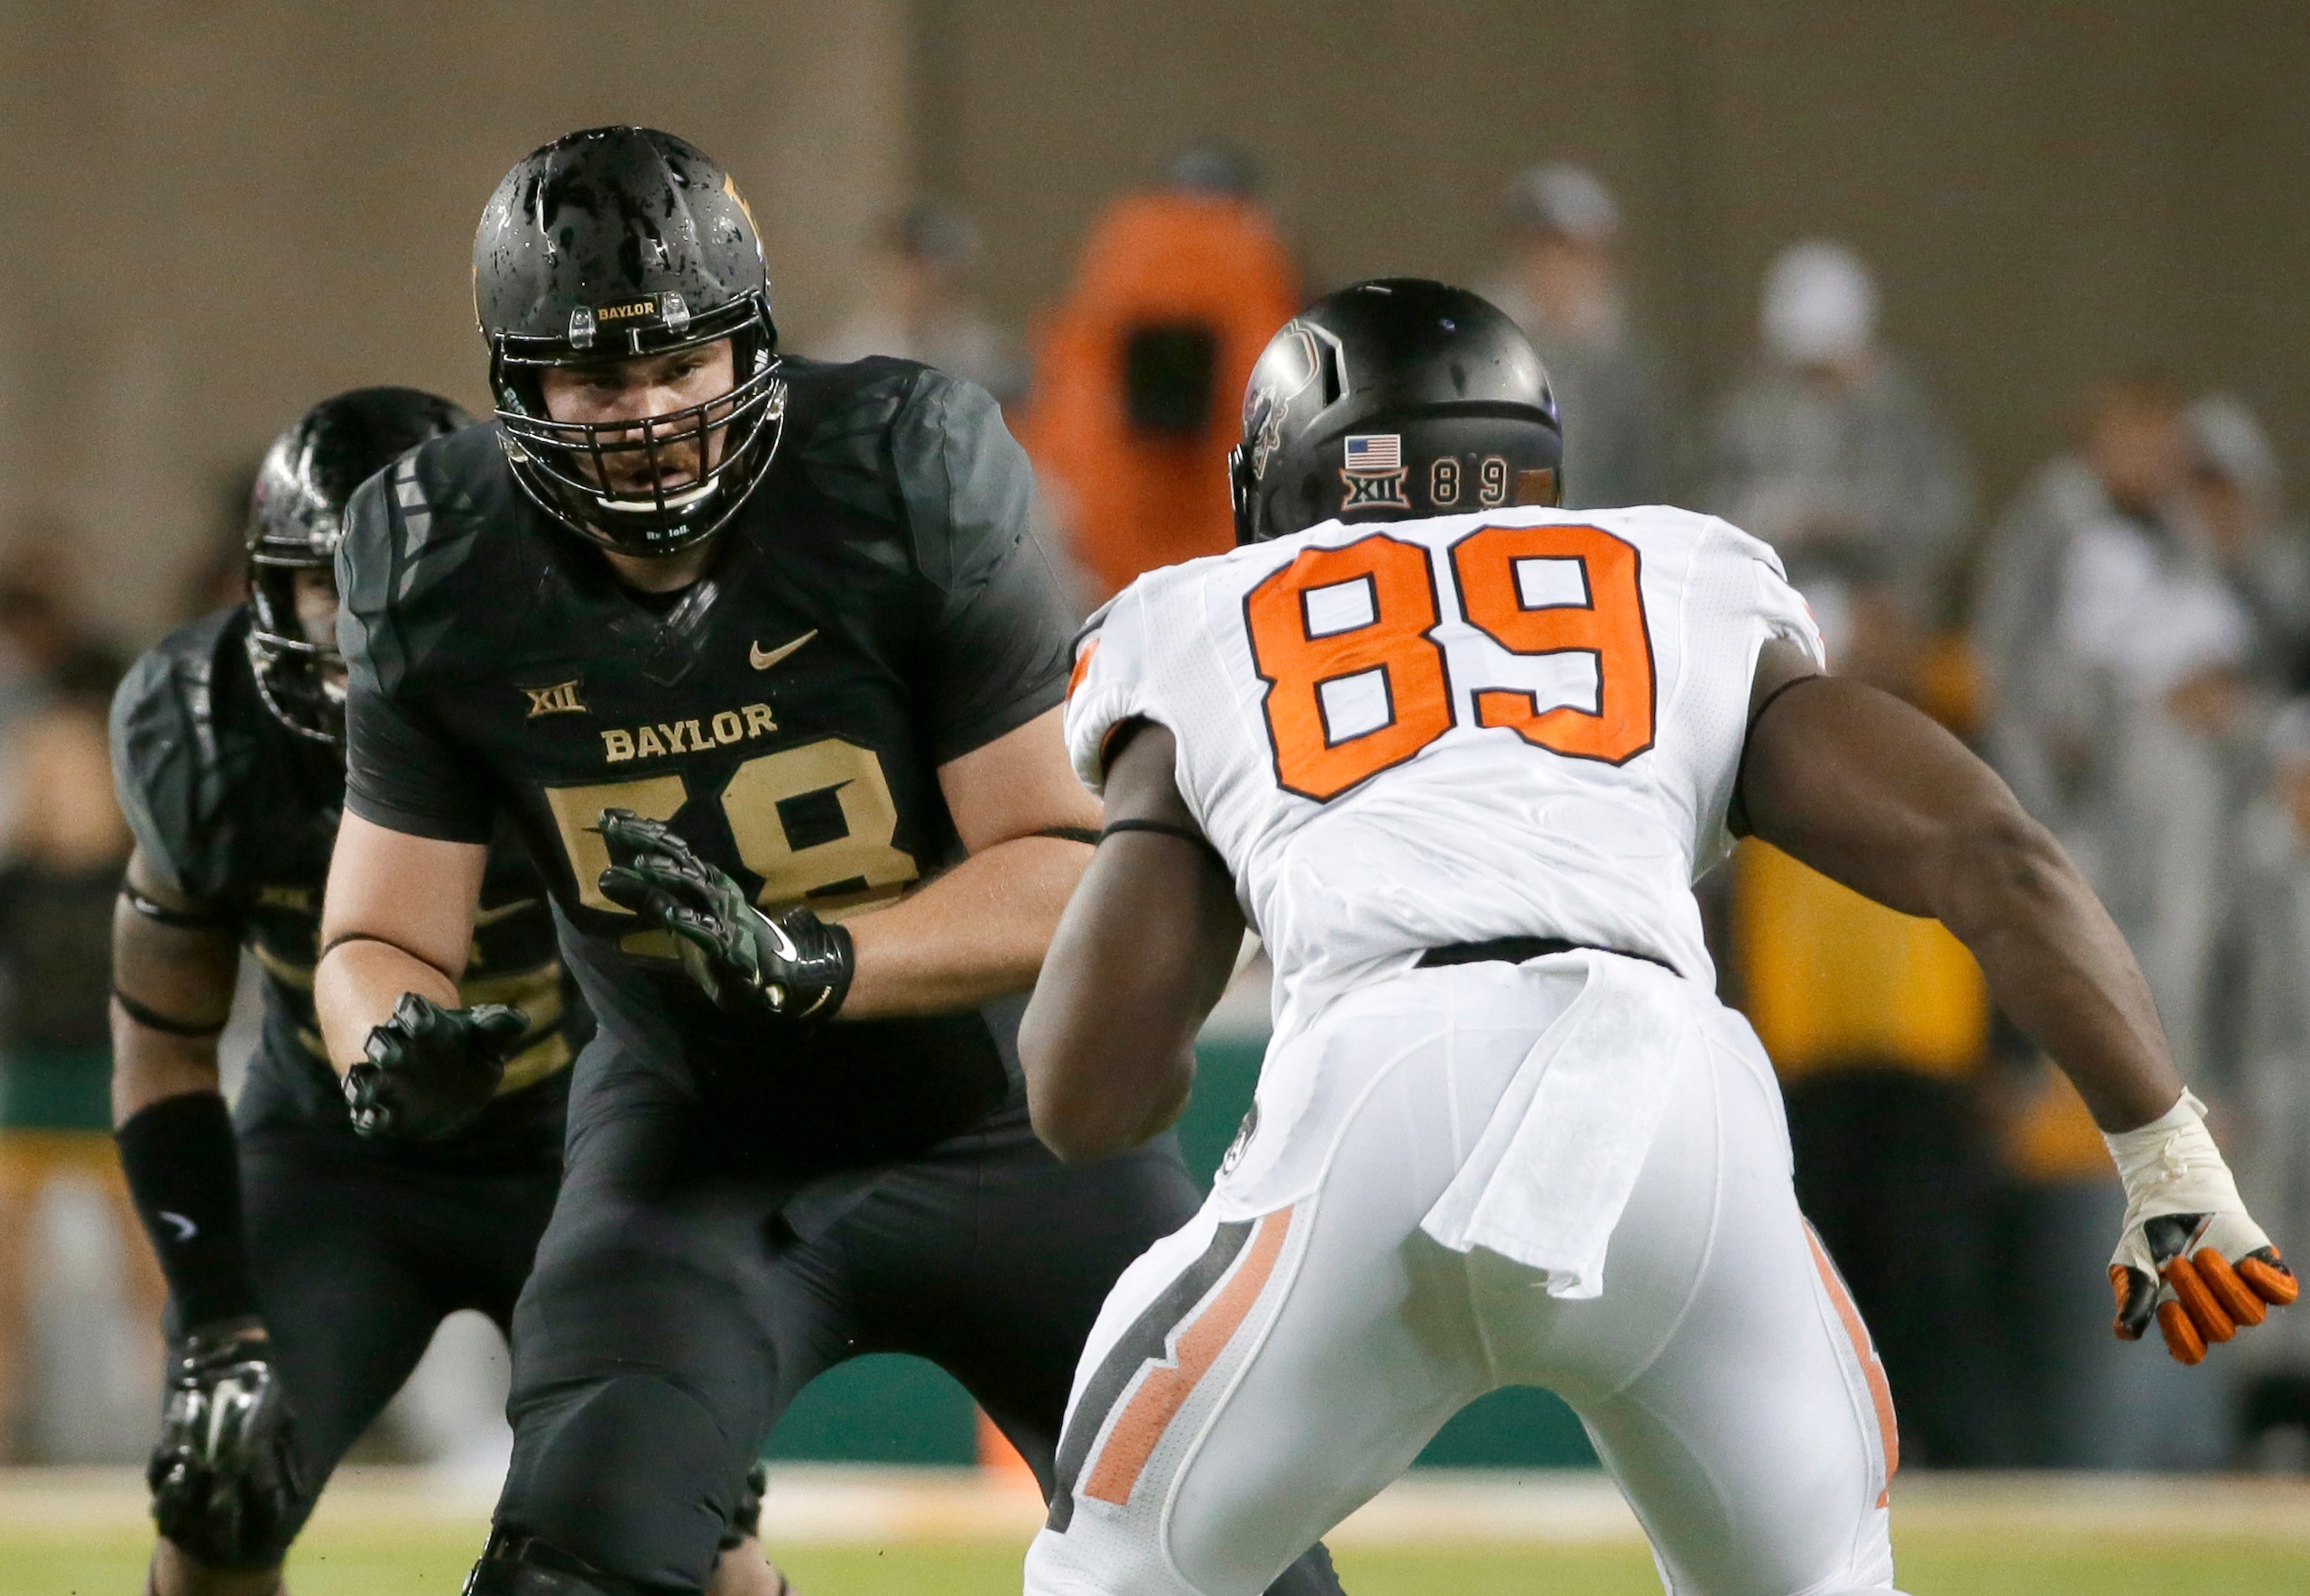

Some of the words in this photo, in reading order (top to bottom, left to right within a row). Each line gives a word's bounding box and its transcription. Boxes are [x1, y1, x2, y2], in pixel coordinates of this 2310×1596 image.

[597, 300, 655, 320] BAYLOR
[1340, 466, 1410, 510] XII
[1242, 522, 1658, 805] 89
[525, 678, 587, 719] XII
[600, 702, 779, 763] BAYLOR
